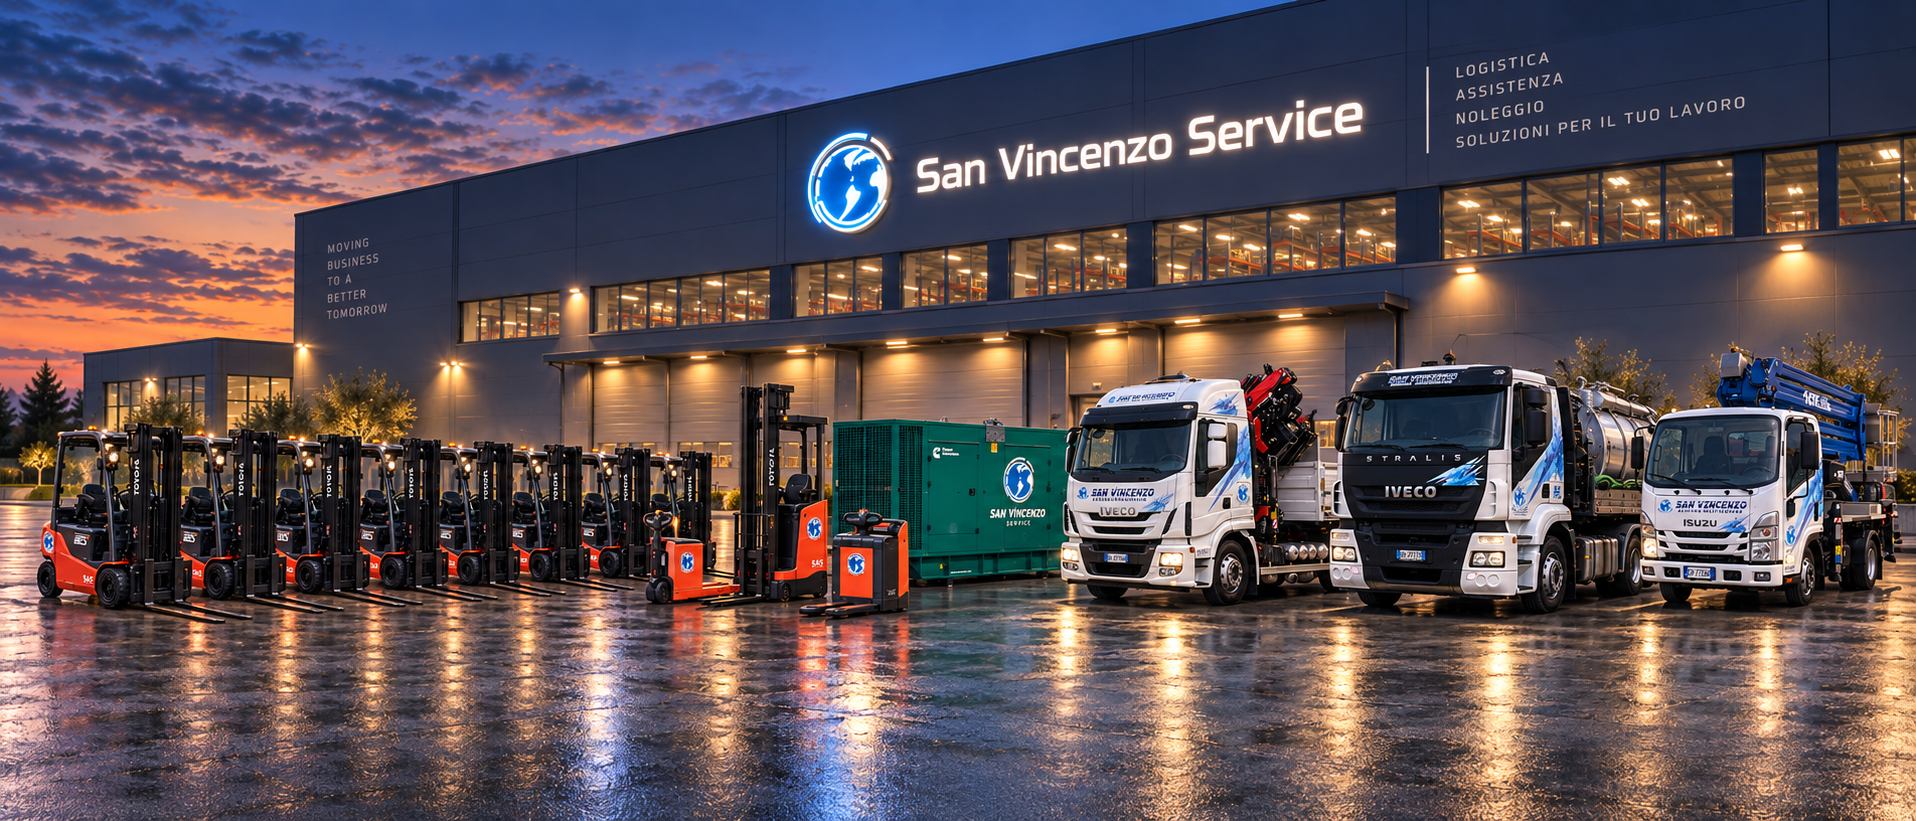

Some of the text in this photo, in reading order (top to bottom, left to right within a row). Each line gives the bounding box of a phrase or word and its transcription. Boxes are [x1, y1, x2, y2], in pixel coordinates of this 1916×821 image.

[1455, 51, 1550, 78] LOGISTICA
[1455, 72, 1564, 102] ASSISTENZA
[1455, 100, 1545, 125] NOLEGGIO
[1455, 96, 1746, 149] SOLUZIONI PER IL TUO LAVORO
[916, 99, 1364, 194] San Vincenzo Service
[327, 237, 369, 254] MOVING
[327, 253, 379, 271] BUSINESS
[327, 273, 352, 287] TO A
[327, 288, 367, 304] BETTER
[326, 302, 388, 320] TOMORROW
[1366, 454, 1461, 463] STRALIS
[1384, 485, 1437, 498] IVECO
[1100, 506, 1136, 516] IVECO
[1675, 500, 1696, 509] SAN
[990, 508, 1007, 519] SAN
